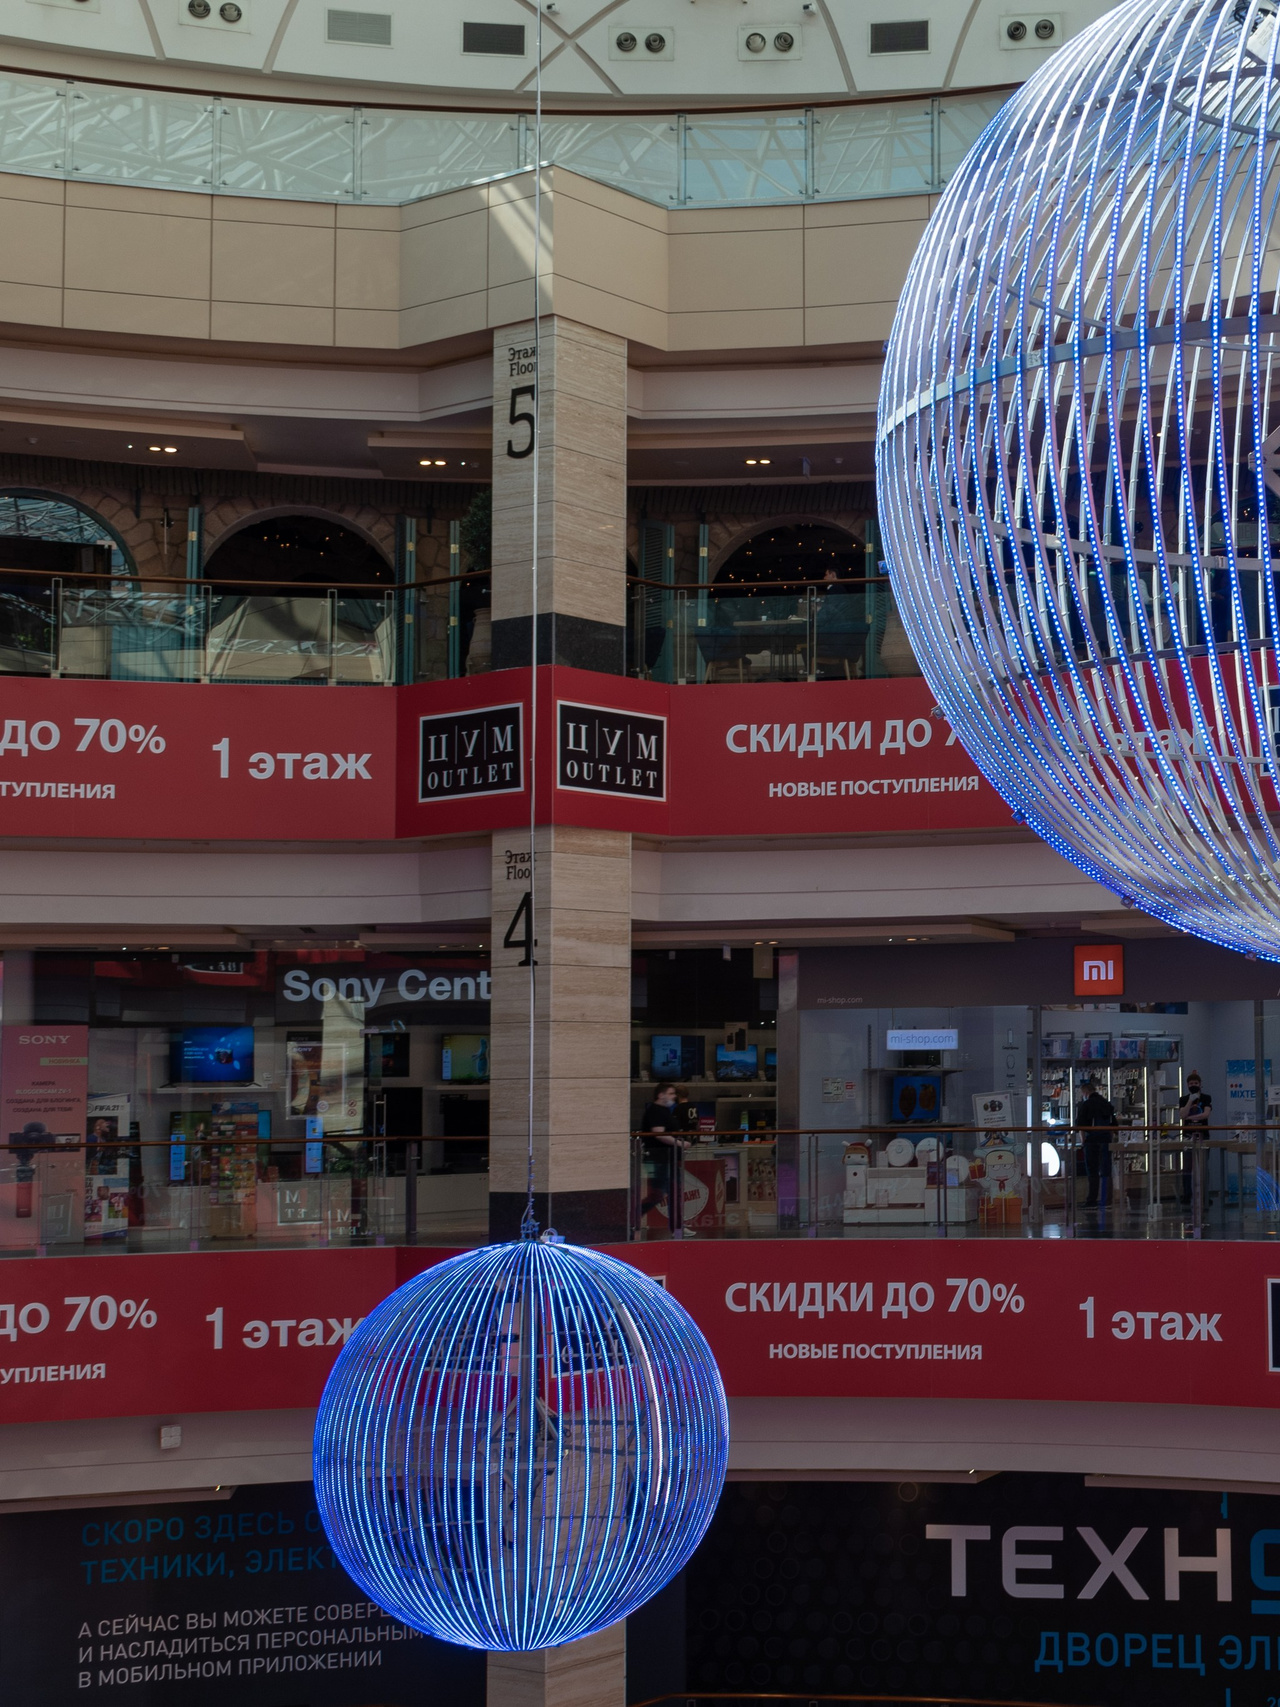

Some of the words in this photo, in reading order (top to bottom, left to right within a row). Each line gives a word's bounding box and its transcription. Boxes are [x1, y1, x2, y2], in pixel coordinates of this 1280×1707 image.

[507, 384, 538, 459] 5
[74, 718, 166, 754] 70%
[428, 724, 514, 762] ЦУМ
[566, 722, 658, 761] ЦУМ
[725, 720, 872, 758] СКИДКИ
[879, 718, 933, 756] ДО
[212, 737, 230, 778] 1
[248, 751, 373, 780] этаж
[427, 762, 514, 790] OUTLET
[566, 760, 658, 789] OUTLET
[769, 781, 837, 797] НОВЫЕ
[841, 776, 979, 796] ПОСТУПЛЕНИЯ
[506, 865, 536, 880] Floo
[504, 891, 538, 967] 4
[283, 969, 385, 1008] Sony
[817, 996, 863, 1005] mi-shop.com
[19, 1035, 70, 1045] SONY
[890, 1033, 954, 1046] mi-shop.com
[64, 1295, 158, 1333] 70%
[725, 1281, 874, 1319] СКИДКИ
[881, 1281, 935, 1319] ДО
[946, 1278, 1025, 1314] 70%
[205, 1307, 224, 1350] 1
[242, 1317, 365, 1350] этаж
[1079, 1296, 1095, 1338] 1
[1111, 1310, 1223, 1342] этаж
[769, 1343, 838, 1359] НОВЫЕ
[842, 1344, 983, 1360] ПОСТУПЛЕНИЯ
[82, 1517, 184, 1547] СКОРО
[194, 1512, 295, 1543] ЗДЕСЬ
[80, 1553, 235, 1585] ТЕХНИКИ,
[78, 1622, 92, 1639] А
[98, 1614, 180, 1637] СЕЙЧАС
[186, 1612, 218, 1629] ВЫ
[223, 1606, 308, 1628] МОЖЕТЕ
[79, 1646, 92, 1663] И
[100, 1635, 250, 1662] НАСЛАДИТЬСЯ
[256, 1624, 424, 1650] ПЕРСОНАЛЬНЫМ
[1034, 1631, 1205, 1676] ДВОРЕЦ
[78, 1671, 92, 1688] В
[99, 1659, 231, 1687] МОБИЛЬНОМ
[238, 1649, 382, 1676] ПРИЛОЖЕНИИ
